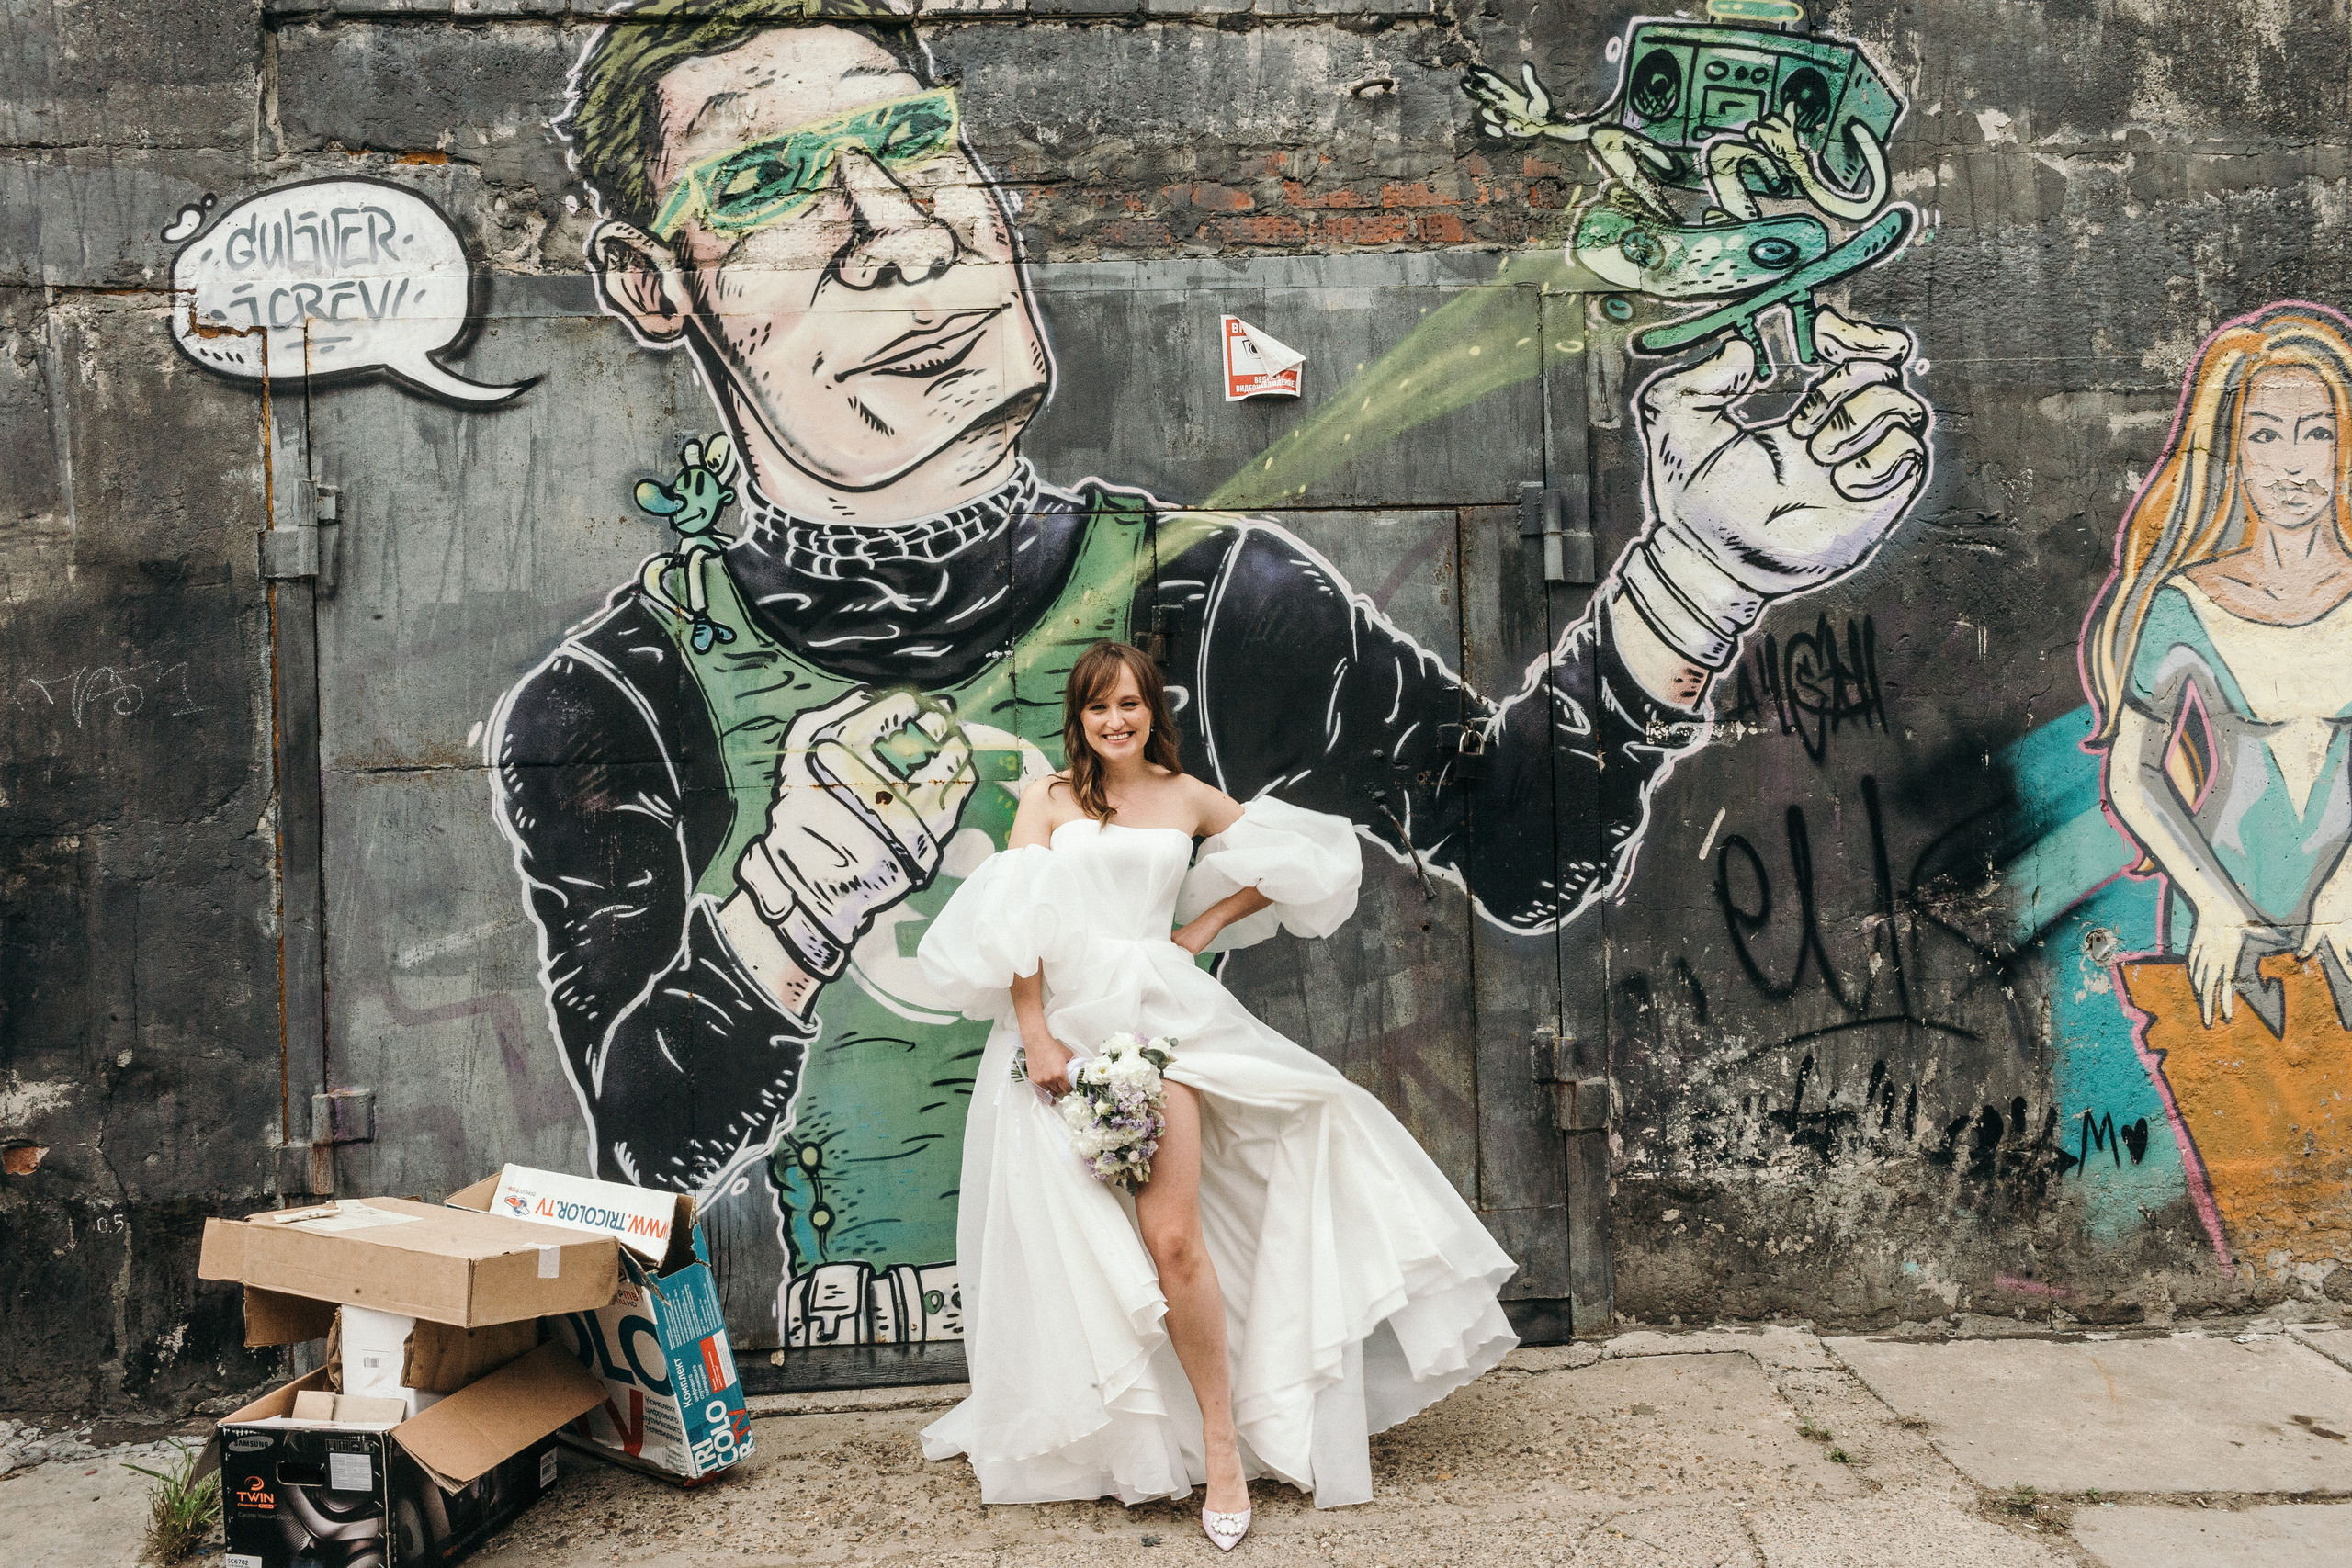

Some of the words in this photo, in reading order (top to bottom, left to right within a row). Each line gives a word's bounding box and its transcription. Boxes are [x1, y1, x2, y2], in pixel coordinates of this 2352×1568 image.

[674, 1358, 694, 1408] Комплект
[234, 1439, 269, 1448] SAMSUNG
[236, 1491, 275, 1503] TWIN
